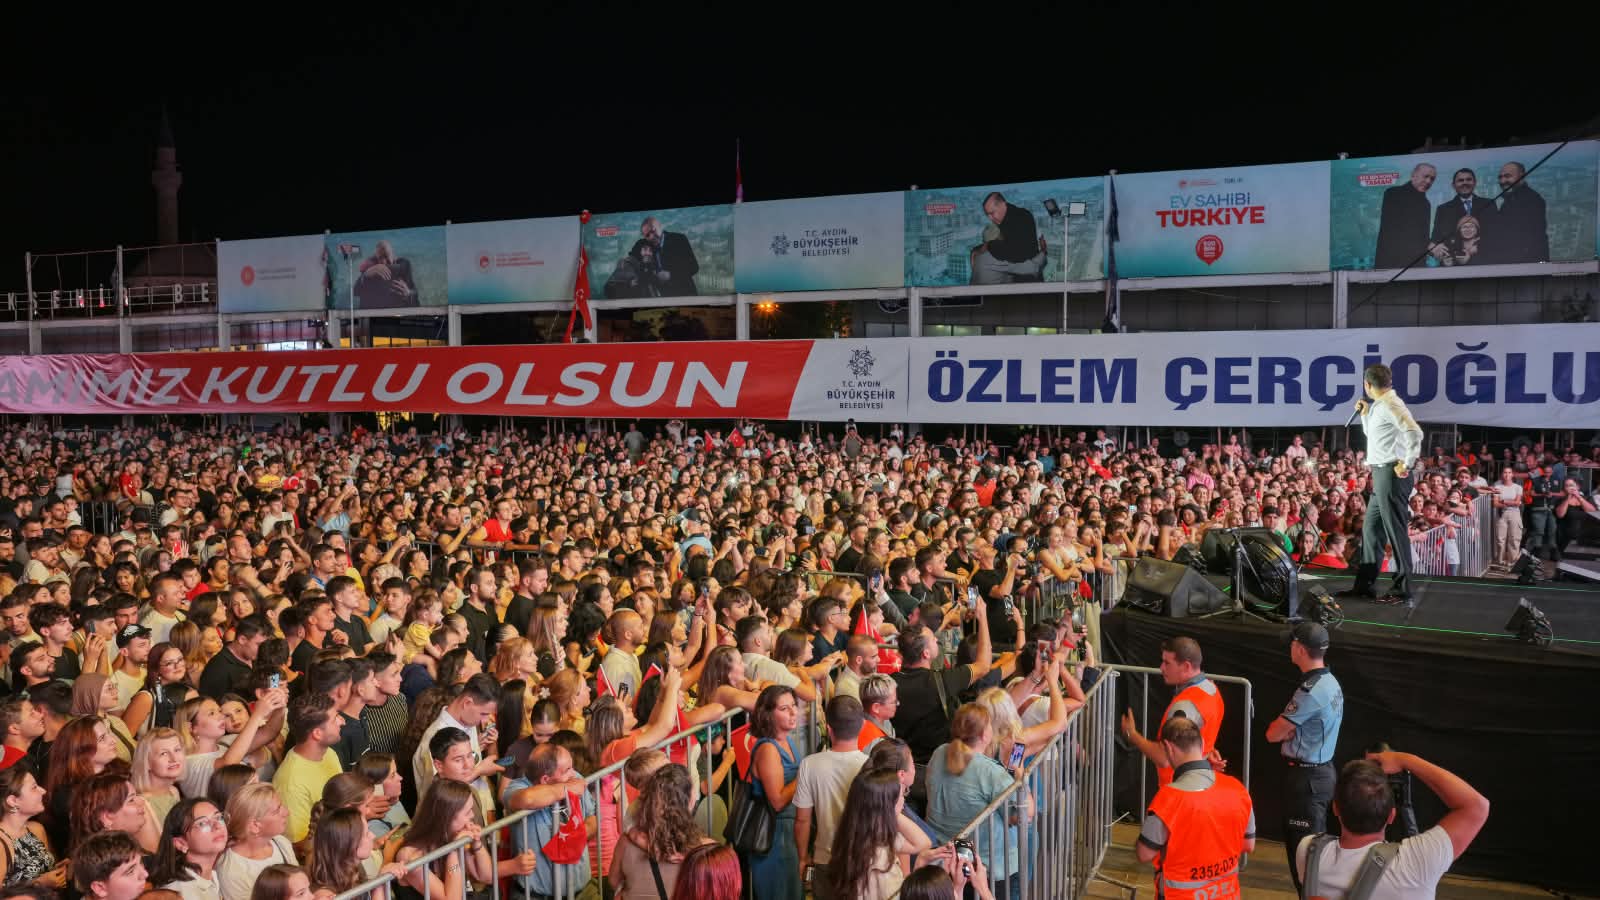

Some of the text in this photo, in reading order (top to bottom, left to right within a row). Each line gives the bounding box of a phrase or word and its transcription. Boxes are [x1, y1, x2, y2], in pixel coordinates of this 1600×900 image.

[1170, 191, 1250, 208] EV SAHİBİ
[1156, 206, 1265, 228] TÜRKİYE
[821, 228, 847, 237] AYDIN
[793, 235, 859, 249] BÜYÜKŞEHİR
[858, 380, 881, 388] AYDIN
[927, 350, 1137, 403] ÖZLEM
[199, 363, 431, 404] KUTLU
[446, 361, 748, 408] OLSUN
[827, 388, 895, 401] BÜYÜKŞEHİR
